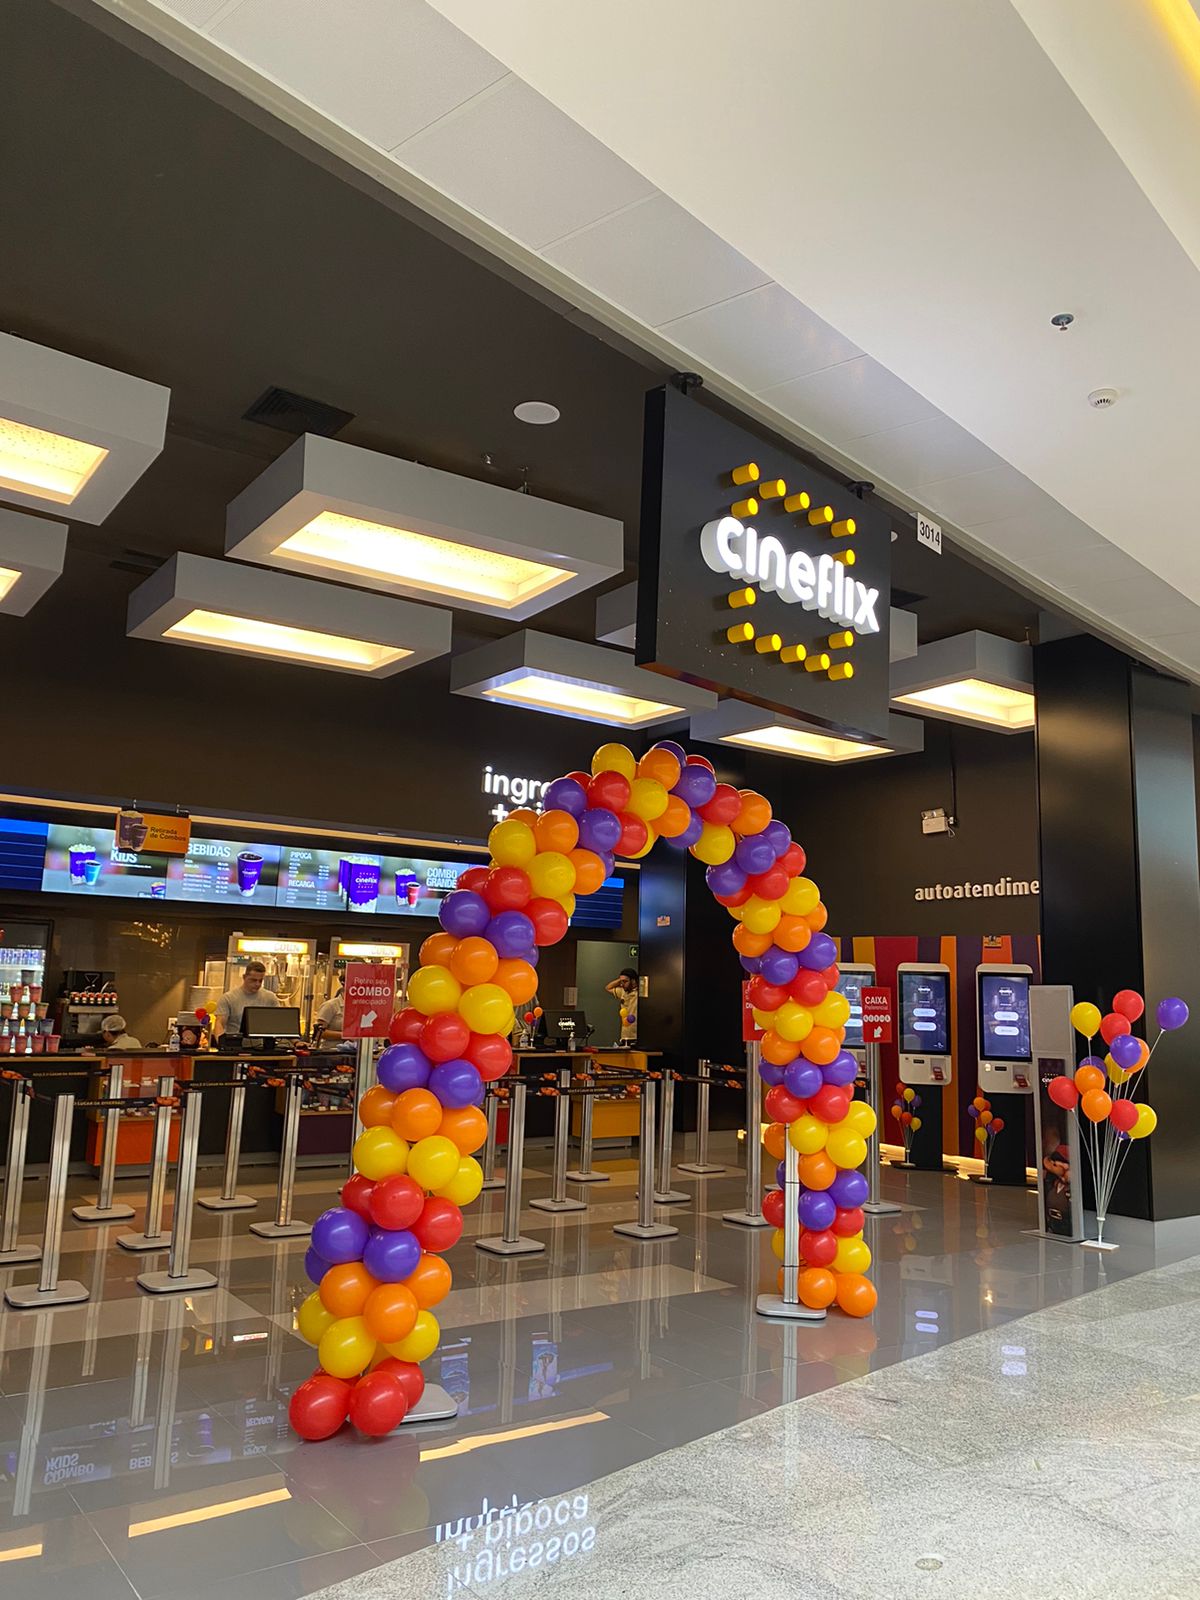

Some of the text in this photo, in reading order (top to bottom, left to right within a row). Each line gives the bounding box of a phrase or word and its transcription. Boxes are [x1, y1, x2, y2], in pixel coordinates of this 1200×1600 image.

[919, 521, 940, 546] 3014
[702, 516, 880, 634] cineflix
[427, 867, 458, 879] COMBO
[426, 877, 458, 889] GRANDE
[914, 877, 1040, 901] autoatendime
[349, 986, 391, 997] COMBO
[864, 995, 888, 1005] CAIXA
